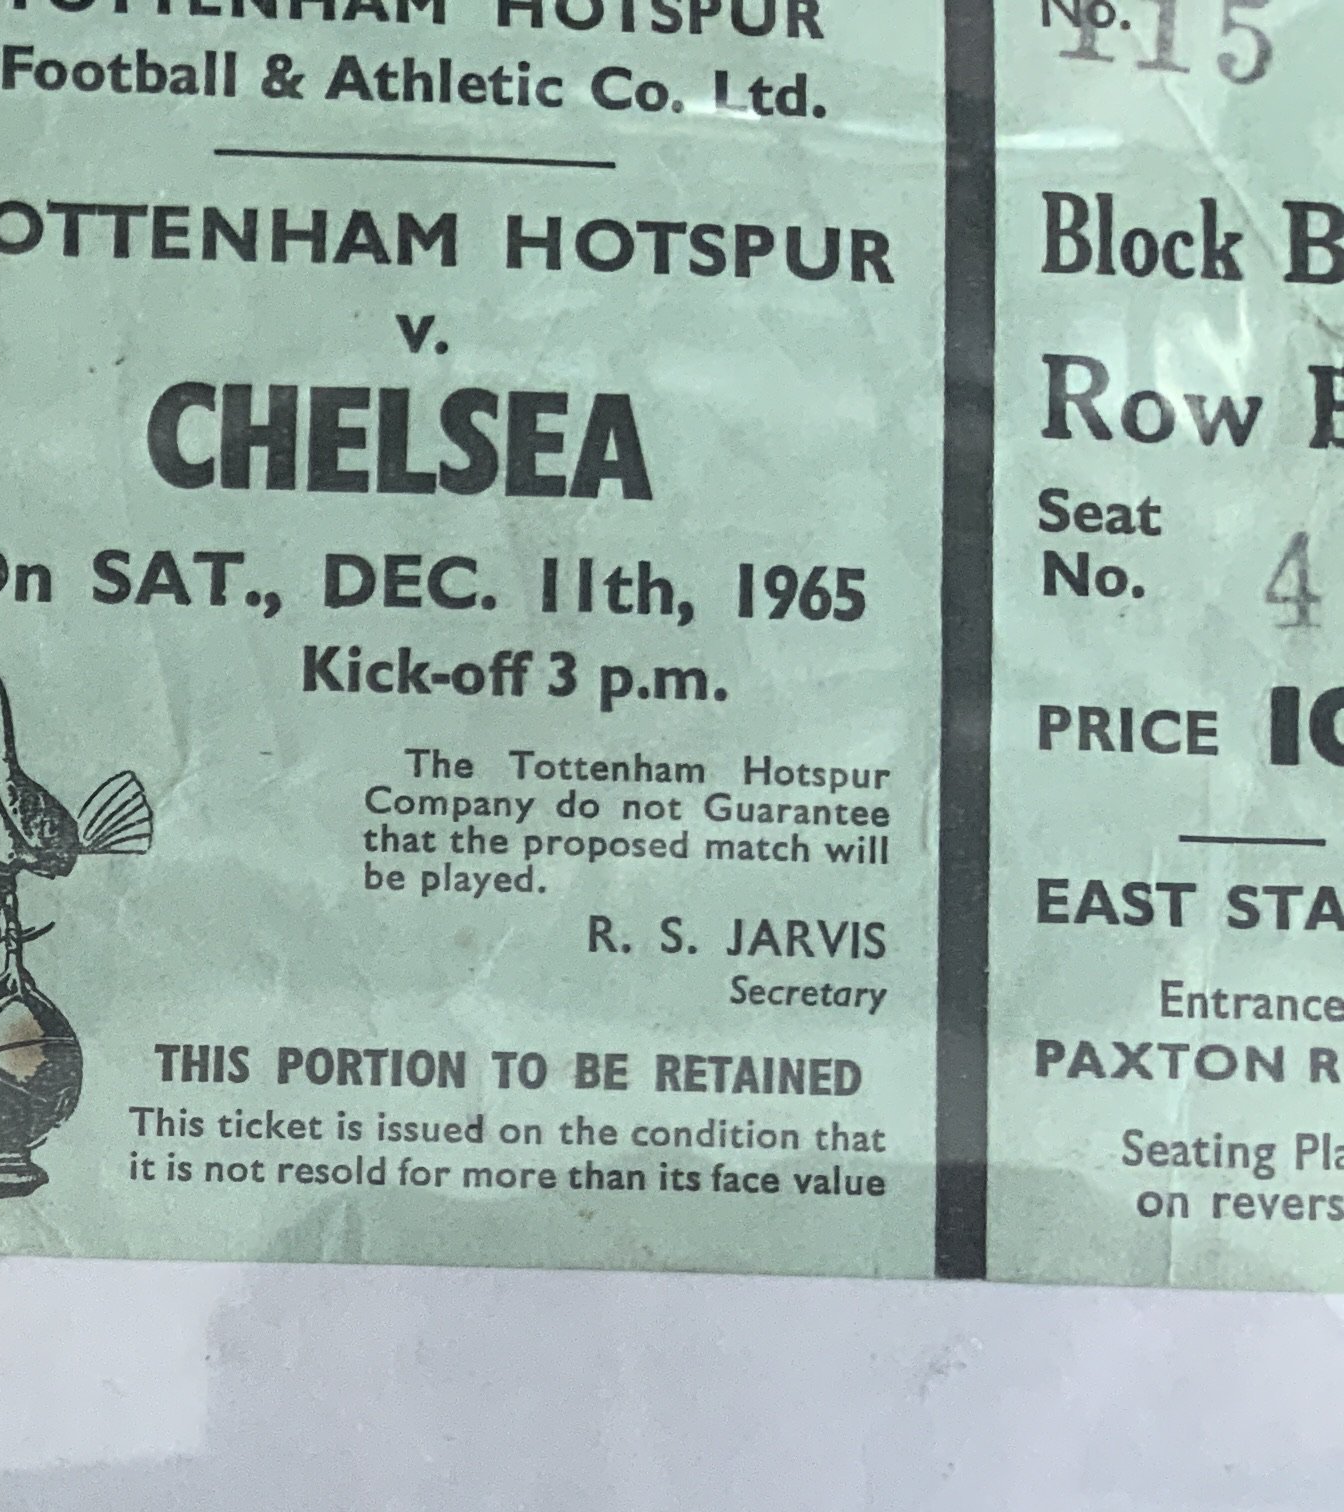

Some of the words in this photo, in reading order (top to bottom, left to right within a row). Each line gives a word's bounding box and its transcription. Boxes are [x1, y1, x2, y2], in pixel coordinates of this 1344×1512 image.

[1, 44, 237, 97] Football
[260, 53, 306, 100] &
[324, 55, 563, 107] Athletic
[591, 65, 685, 114] Co.
[714, 70, 827, 119] Ltd.
[505, 213, 894, 284] HOTSPUR
[1041, 191, 1244, 281] Block
[1041, 353, 1263, 447] Row
[147, 381, 652, 501] CHELSEA
[1038, 487, 1162, 537] Seat
[92, 550, 282, 619] SAT.,
[324, 553, 496, 612] DEC.
[737, 563, 868, 623] 1965
[1042, 551, 1146, 599] No.
[302, 645, 534, 697] Kick-off
[600, 664, 729, 712] p.m.
[1038, 704, 1219, 756] PRICE
[405, 748, 474, 779] The
[509, 750, 706, 784] Tottenham
[743, 755, 890, 795] Hotspur
[365, 786, 535, 823] Company
[557, 790, 600, 820] do
[623, 793, 682, 822] not
[704, 792, 890, 828] Guarantee
[364, 824, 437, 855] that
[451, 826, 509, 856] the
[524, 832, 689, 862] proposed
[705, 833, 810, 864] match
[825, 835, 890, 866] will
[365, 862, 406, 891] be
[421, 866, 547, 900] played.
[1037, 878, 1197, 927] EAST
[727, 919, 887, 960] JARVIS
[730, 975, 887, 1015] Secretary
[154, 1042, 251, 1085] THIS
[276, 1045, 466, 1089] PORTION
[492, 1051, 548, 1091] TO
[574, 1052, 628, 1091] BE
[655, 1054, 863, 1098] RETAINED
[1034, 1039, 1285, 1084] PAXTON
[129, 1106, 206, 1139] This
[217, 1108, 323, 1141] ticket
[377, 1111, 484, 1145] issued
[499, 1120, 543, 1147] on
[558, 1115, 618, 1148] the
[631, 1117, 800, 1152] condition
[814, 1122, 887, 1153] that
[204, 1158, 266, 1186] not
[277, 1155, 386, 1187] resold
[398, 1158, 450, 1188] for
[462, 1164, 557, 1191] more
[567, 1160, 646, 1193] than
[658, 1162, 701, 1194] its
[711, 1162, 780, 1196] face
[792, 1164, 887, 1198] value
[1121, 1128, 1276, 1181] Seating
